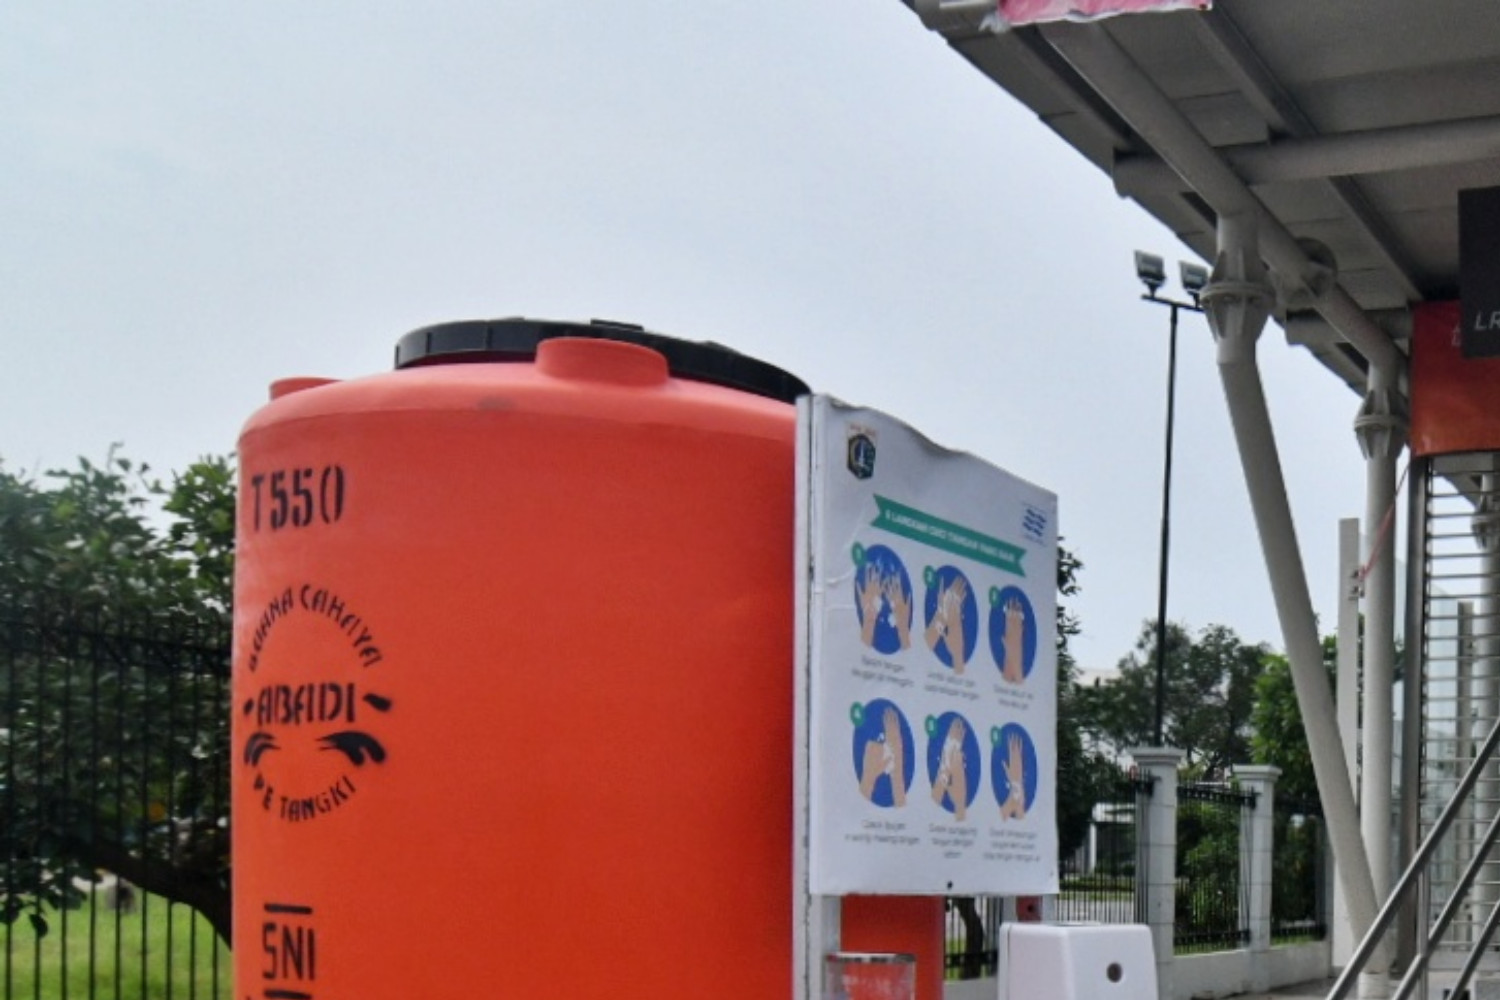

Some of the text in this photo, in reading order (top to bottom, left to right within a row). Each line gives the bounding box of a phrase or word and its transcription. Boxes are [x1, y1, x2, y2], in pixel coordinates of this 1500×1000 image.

[251, 465, 344, 532] T550
[257, 682, 355, 727] ABADI
[280, 775, 356, 822] TANGKI
[262, 921, 316, 981] SNI
